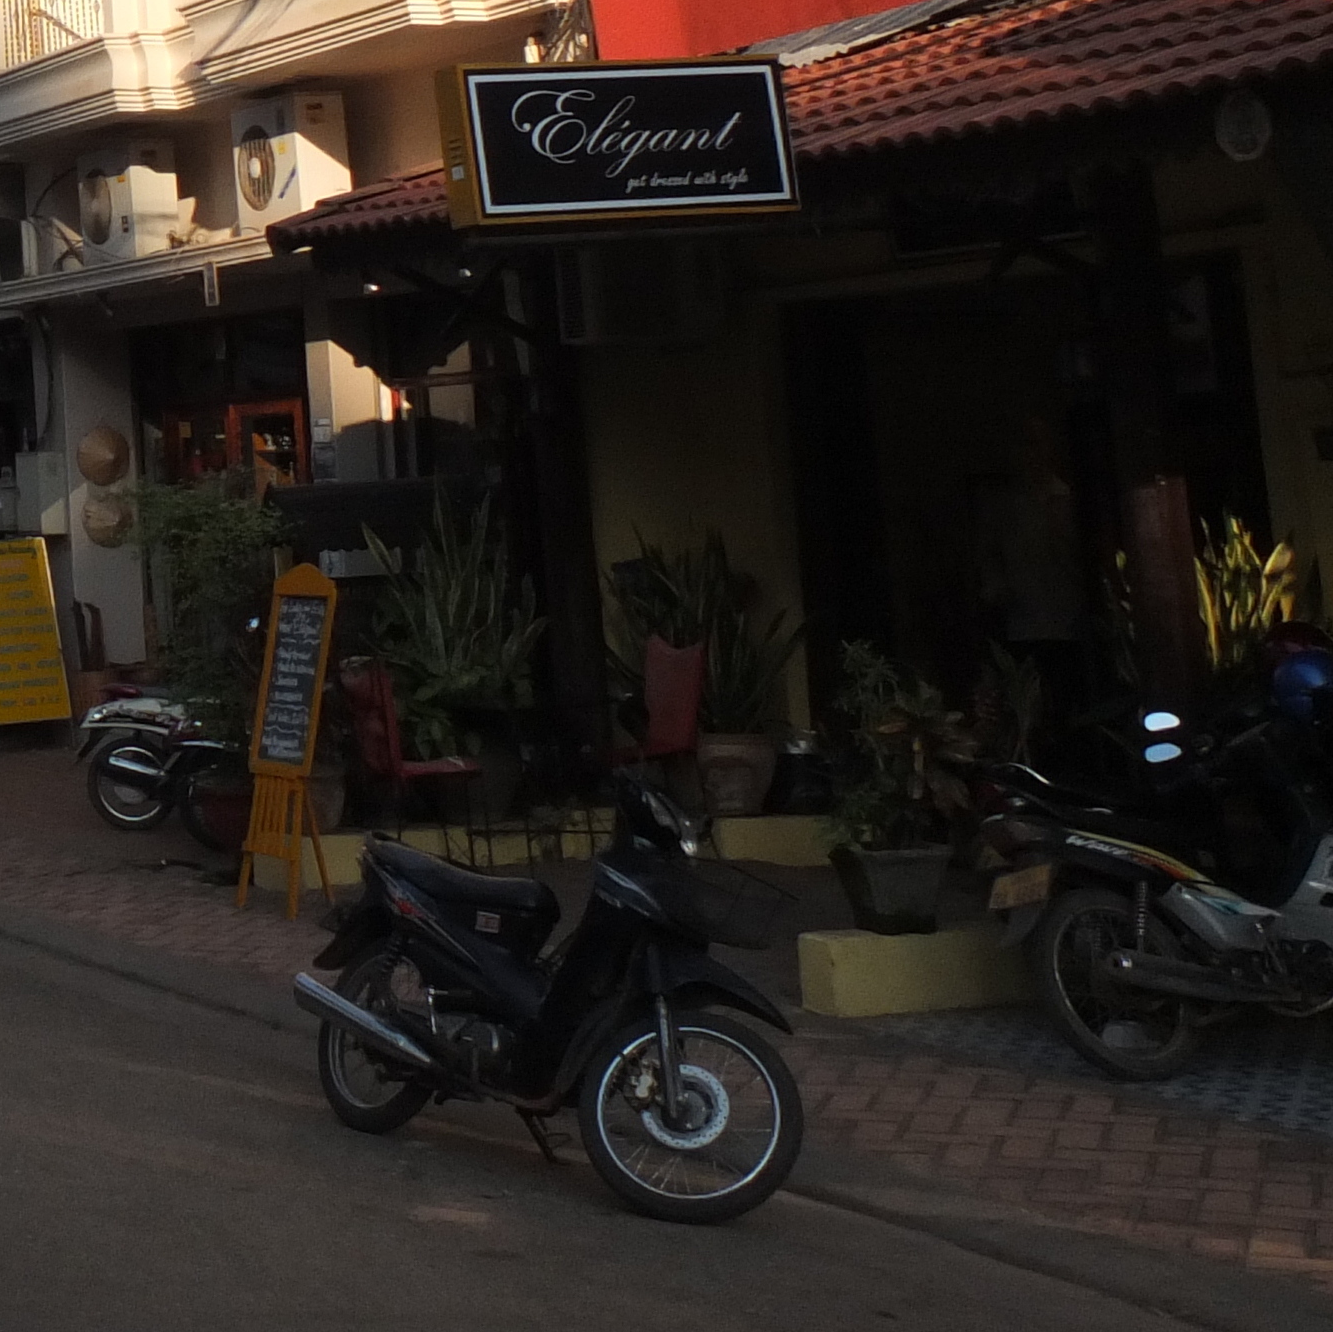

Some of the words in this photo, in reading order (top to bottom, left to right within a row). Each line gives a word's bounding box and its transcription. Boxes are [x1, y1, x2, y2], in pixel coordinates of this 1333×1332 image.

[511, 89, 741, 178] Elégant
[626, 174, 648, 193] get
[720, 167, 749, 190] style
